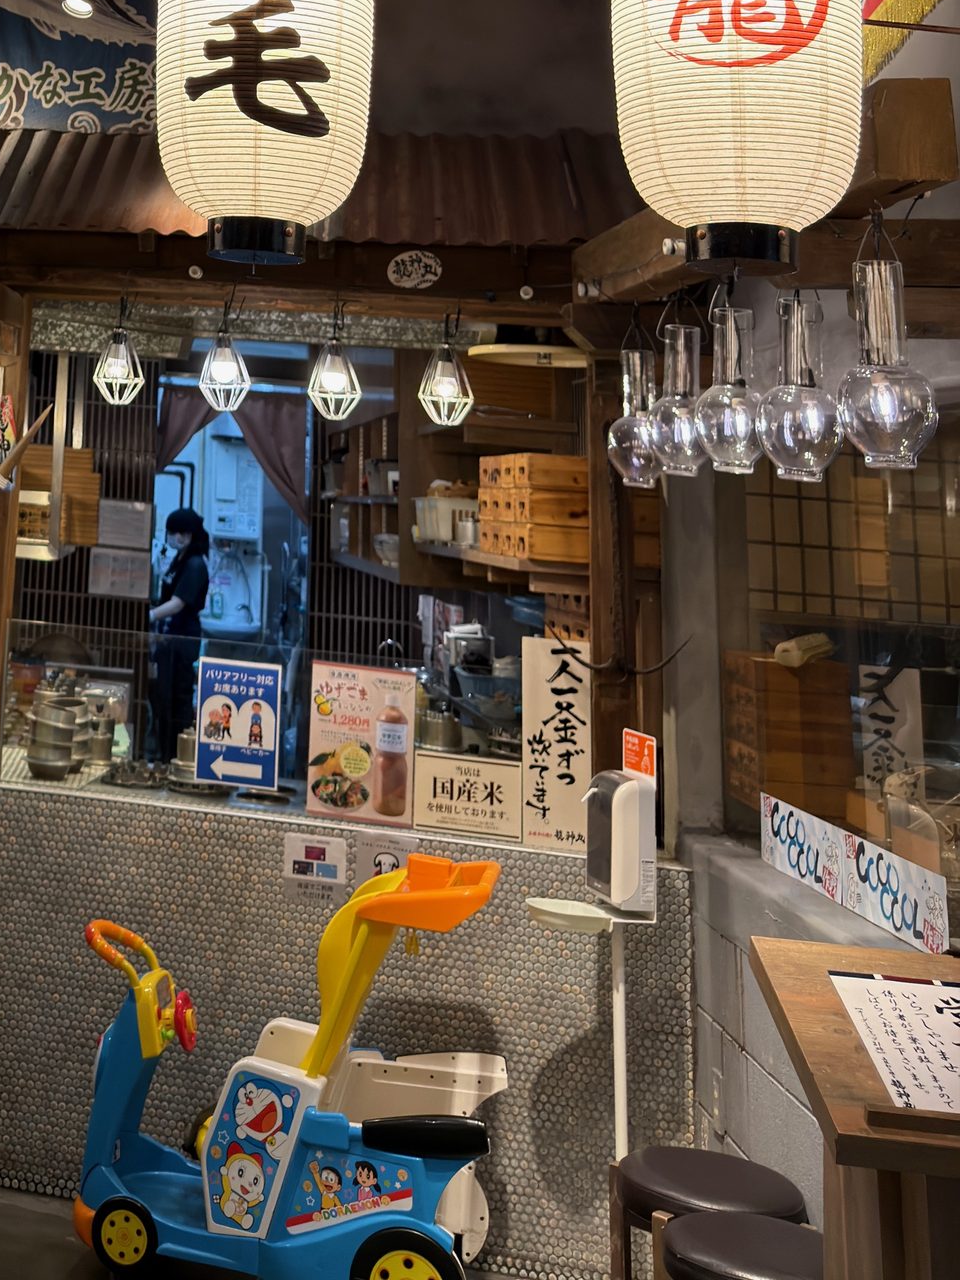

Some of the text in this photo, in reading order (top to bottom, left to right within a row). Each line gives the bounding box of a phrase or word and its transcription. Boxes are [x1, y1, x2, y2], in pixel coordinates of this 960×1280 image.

[433, 776, 503, 805] 国産米
[322, 1196, 381, 1220] DORAEMON
